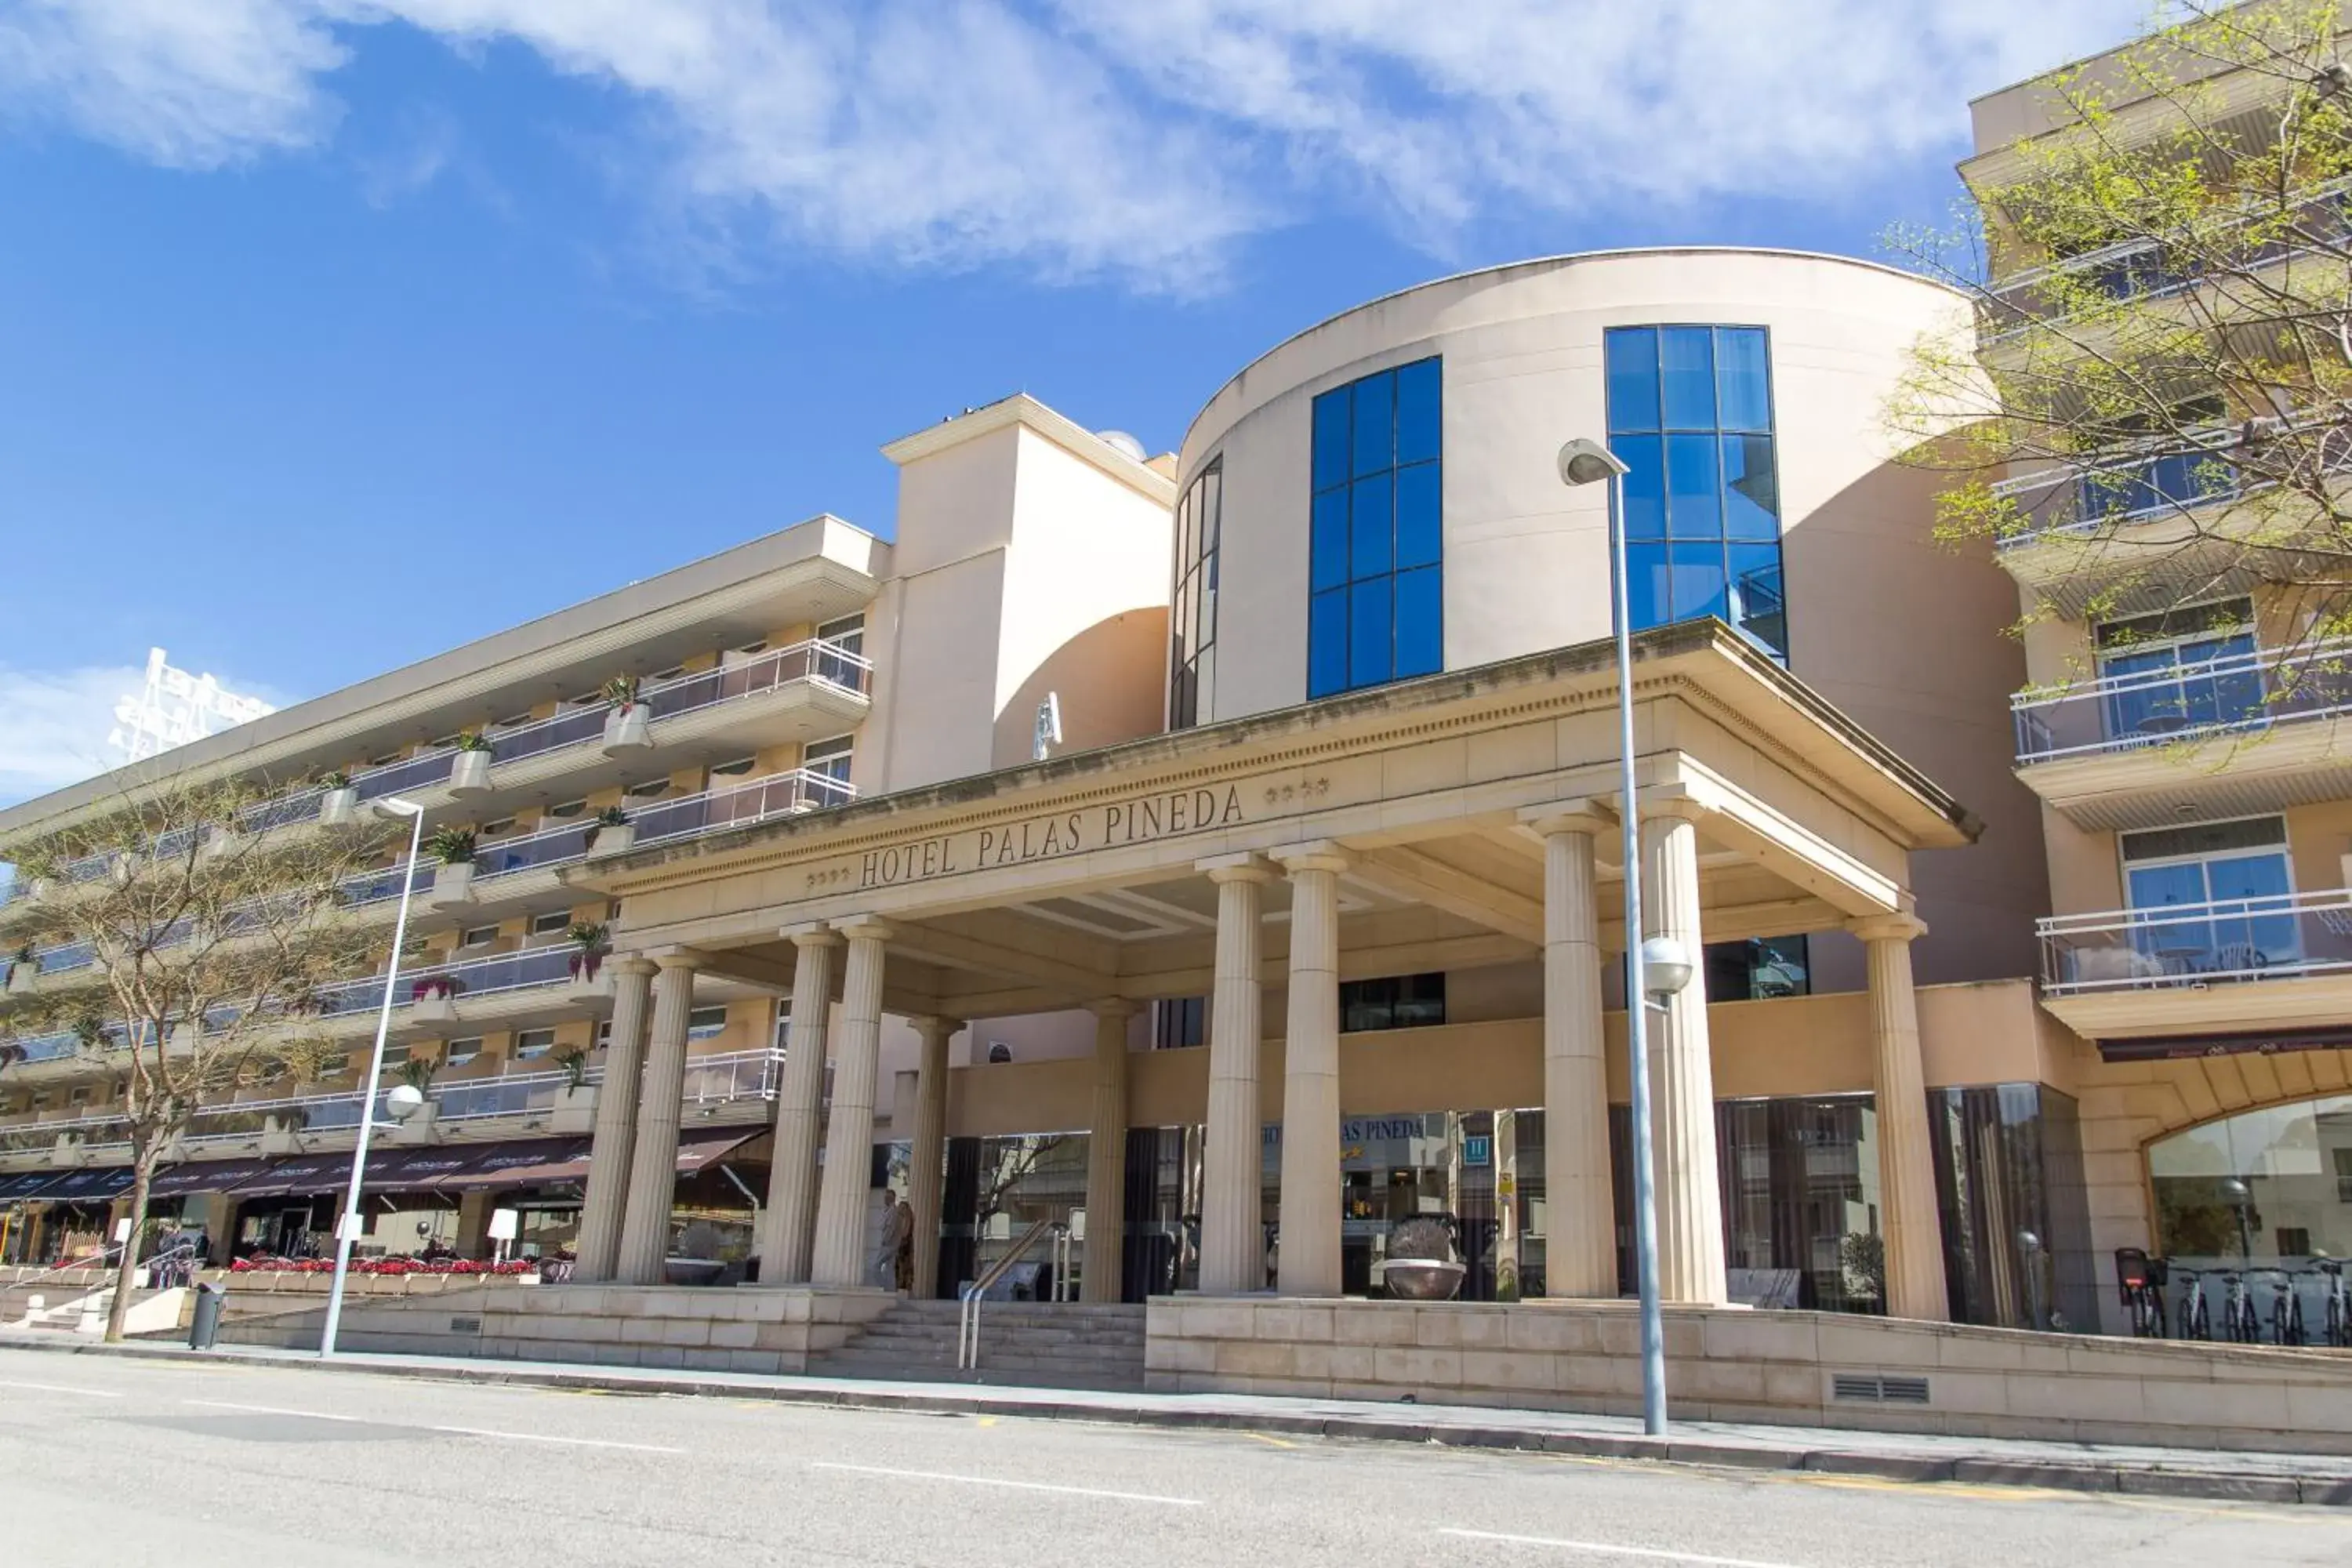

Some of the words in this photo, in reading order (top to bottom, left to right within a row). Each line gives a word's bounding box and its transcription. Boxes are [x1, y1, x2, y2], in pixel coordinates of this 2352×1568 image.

[862, 838, 956, 887] HOTEL
[978, 813, 1082, 866] PALAS
[1104, 783, 1243, 845] PINEDA
[1366, 1116, 1424, 1140] PINEDA
